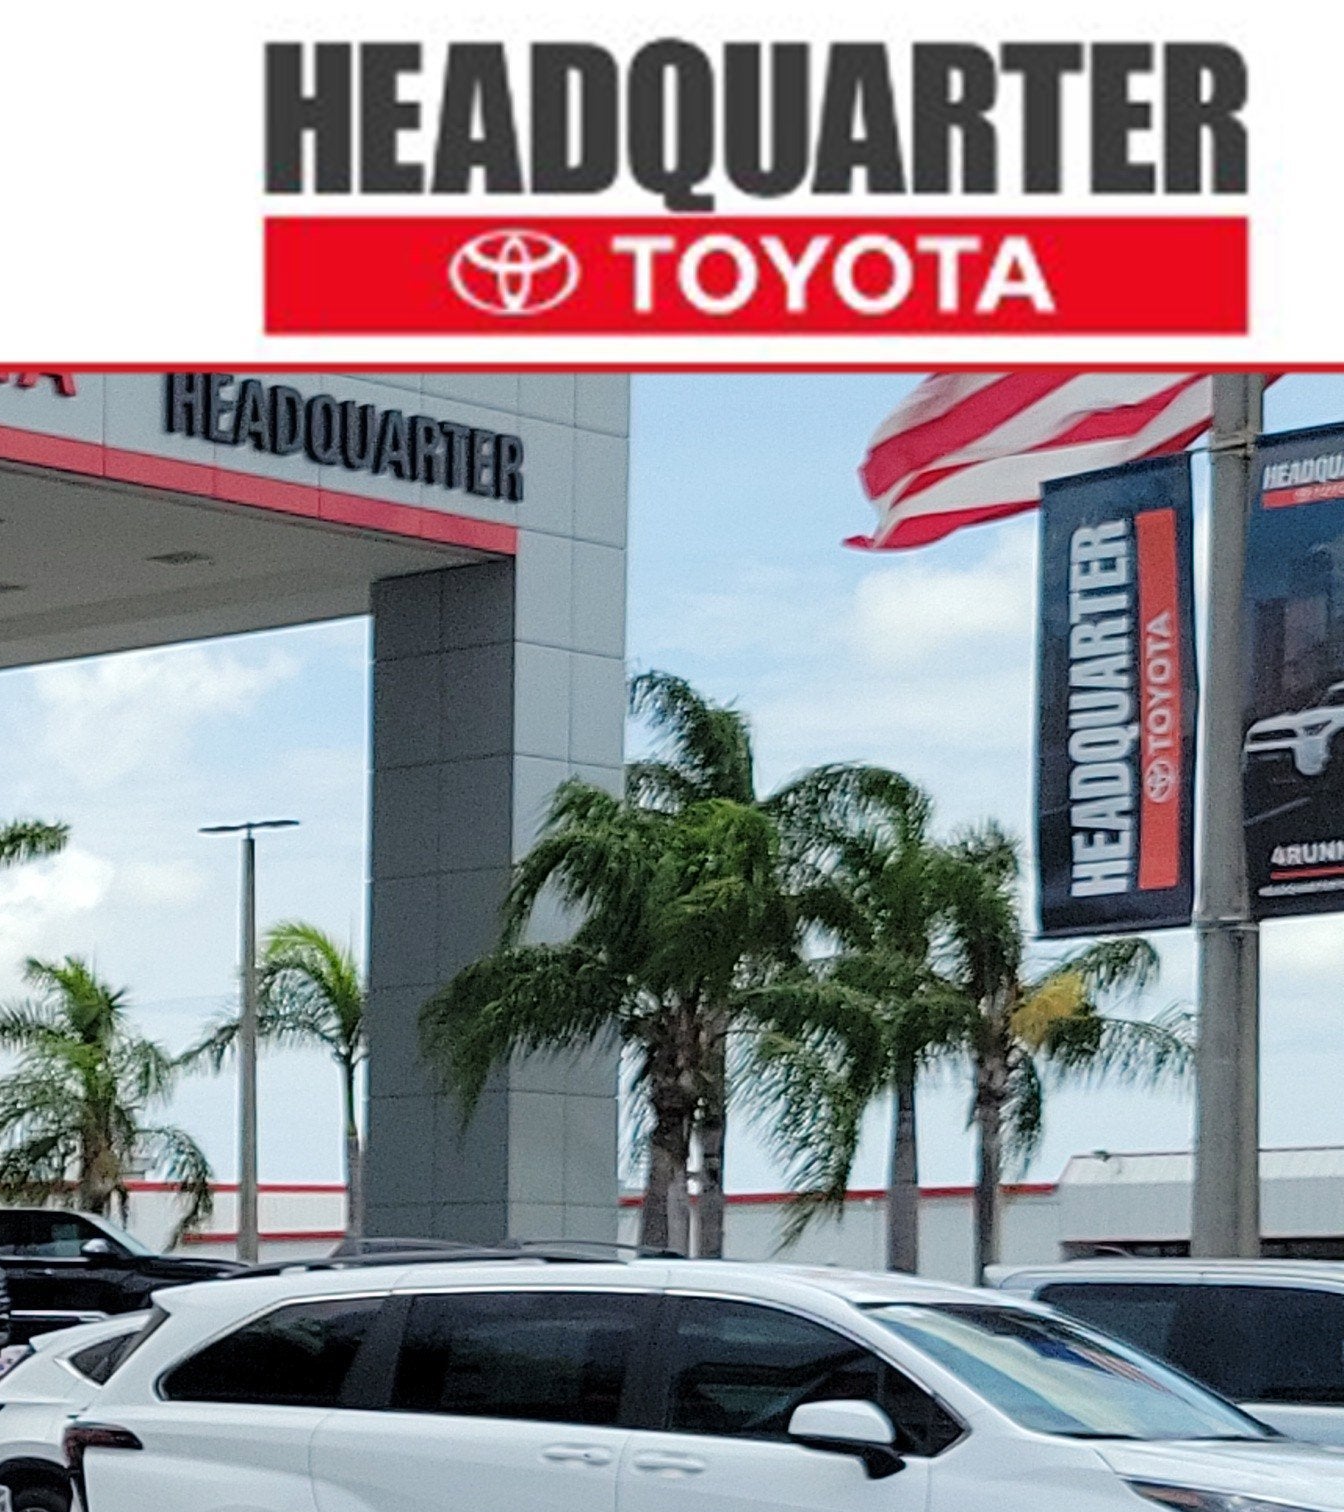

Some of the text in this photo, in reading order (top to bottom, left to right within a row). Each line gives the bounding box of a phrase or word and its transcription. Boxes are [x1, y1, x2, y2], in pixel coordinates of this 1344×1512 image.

[165, 373, 524, 503] HEADQUARTER
[1262, 454, 1344, 490] HEADQU
[1068, 518, 1139, 898] HEADQUARTER
[1145, 611, 1174, 756] TOYOTA
